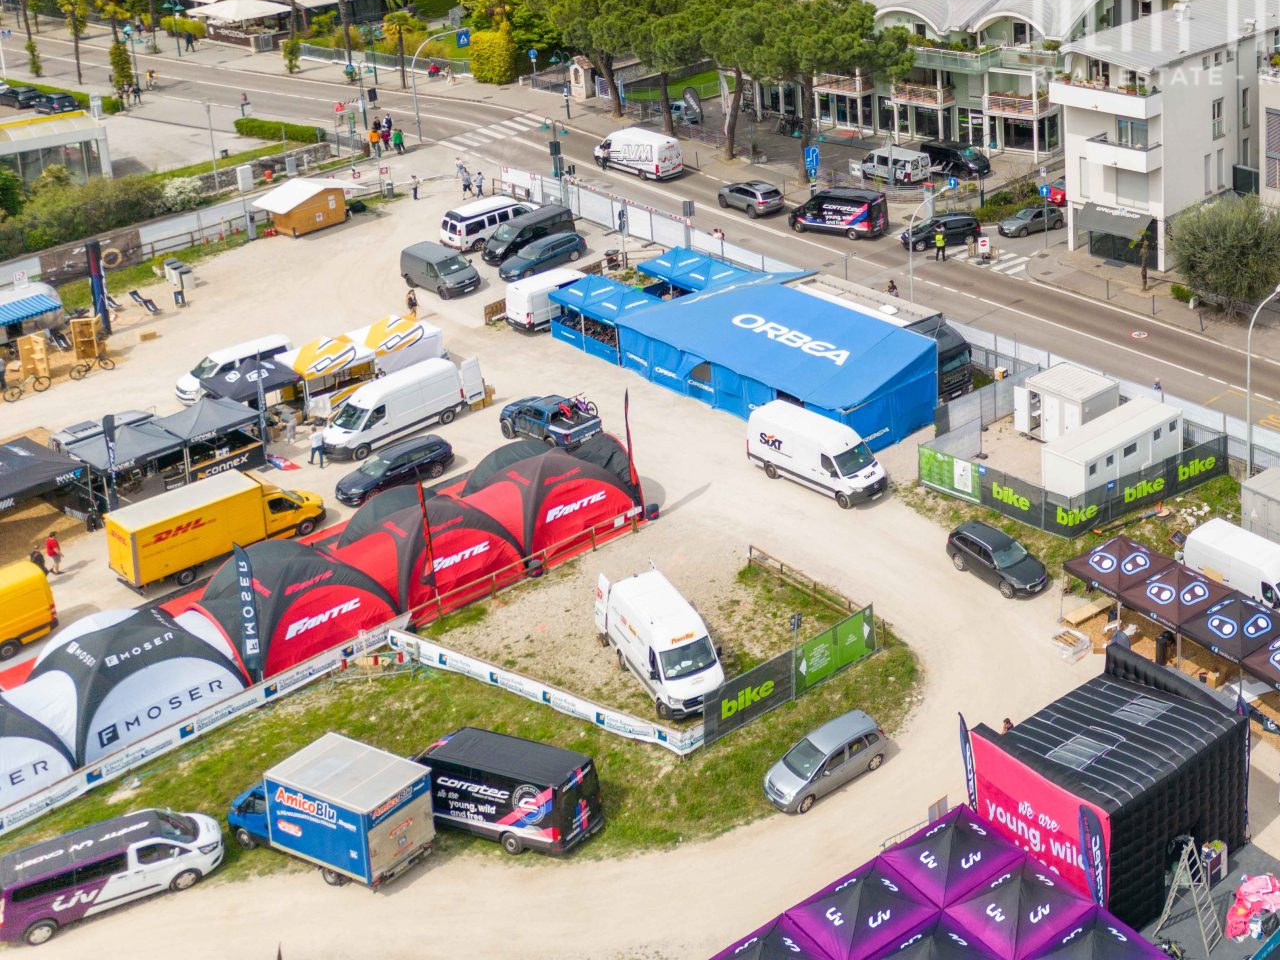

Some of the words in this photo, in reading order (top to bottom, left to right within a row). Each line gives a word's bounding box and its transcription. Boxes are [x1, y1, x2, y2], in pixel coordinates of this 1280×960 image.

[617, 144, 654, 162] AVM
[731, 313, 851, 367] ORBEA
[190, 430, 217, 442] connex
[205, 452, 249, 477] connex
[1177, 454, 1217, 482] bike
[992, 481, 1030, 511] bike
[1124, 475, 1165, 503] bike
[545, 490, 607, 523] FANTIC
[1056, 502, 1099, 528] bike
[153, 518, 205, 544] DHL
[284, 597, 361, 641] FANTIC
[120, 632, 174, 661] MOSER
[125, 679, 223, 732] MOSER
[721, 680, 775, 720] bike
[437, 776, 510, 799] corratec
[275, 787, 337, 823] AmicoBlu
[449, 800, 478, 813] young,
[478, 804, 496, 814] wild
[450, 809, 466, 818] and
[986, 800, 1045, 852] young,
